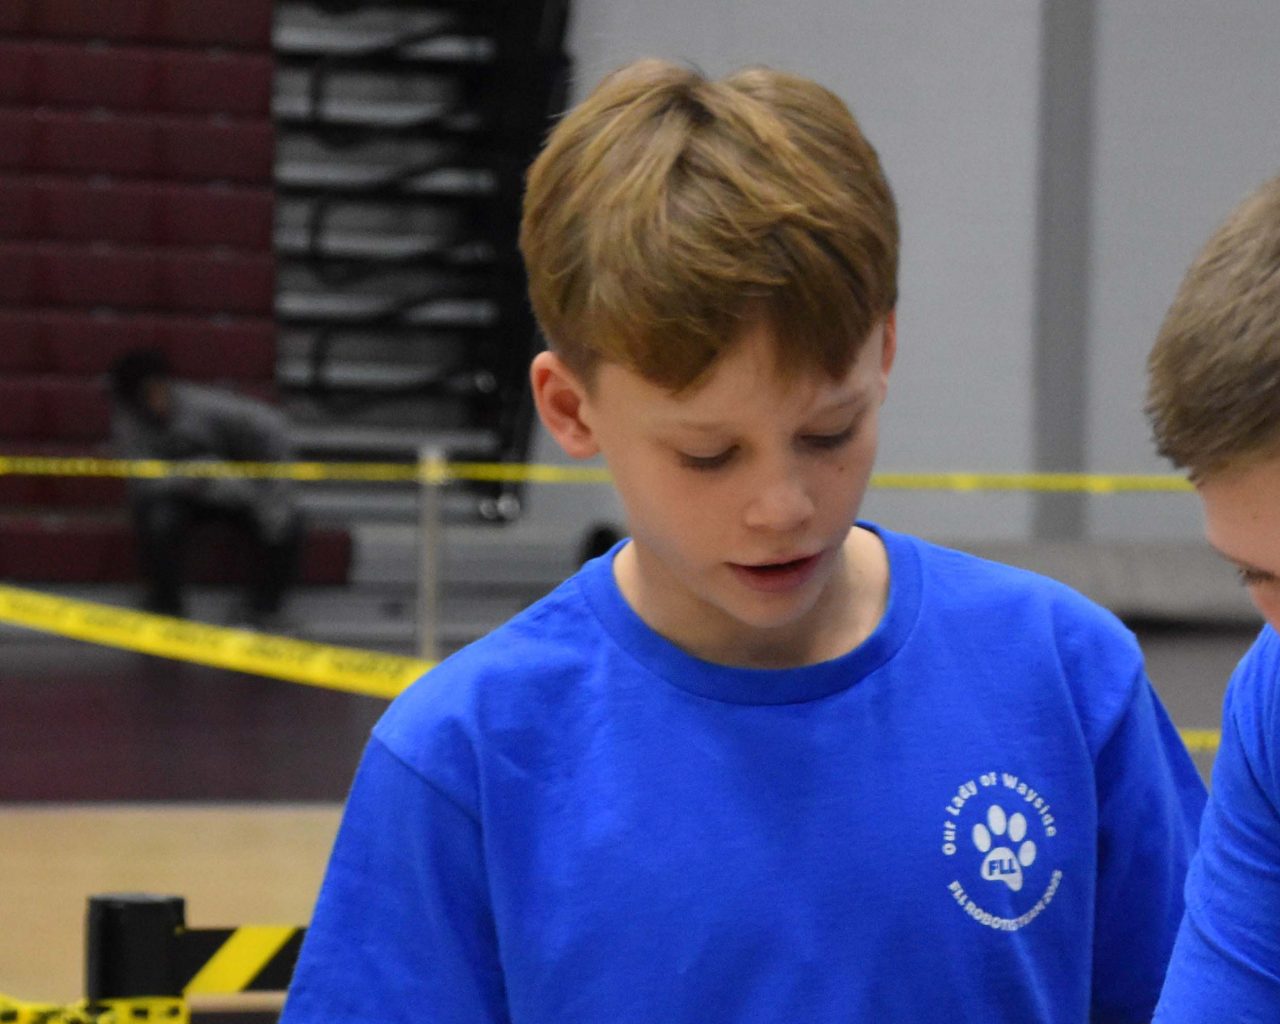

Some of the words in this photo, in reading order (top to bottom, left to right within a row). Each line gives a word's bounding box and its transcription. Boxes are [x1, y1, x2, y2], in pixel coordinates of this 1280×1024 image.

[945, 780, 978, 816] Lady
[979, 771, 997, 787] of
[1002, 773, 1057, 837] Wayside
[988, 858, 1017, 876] FLL
